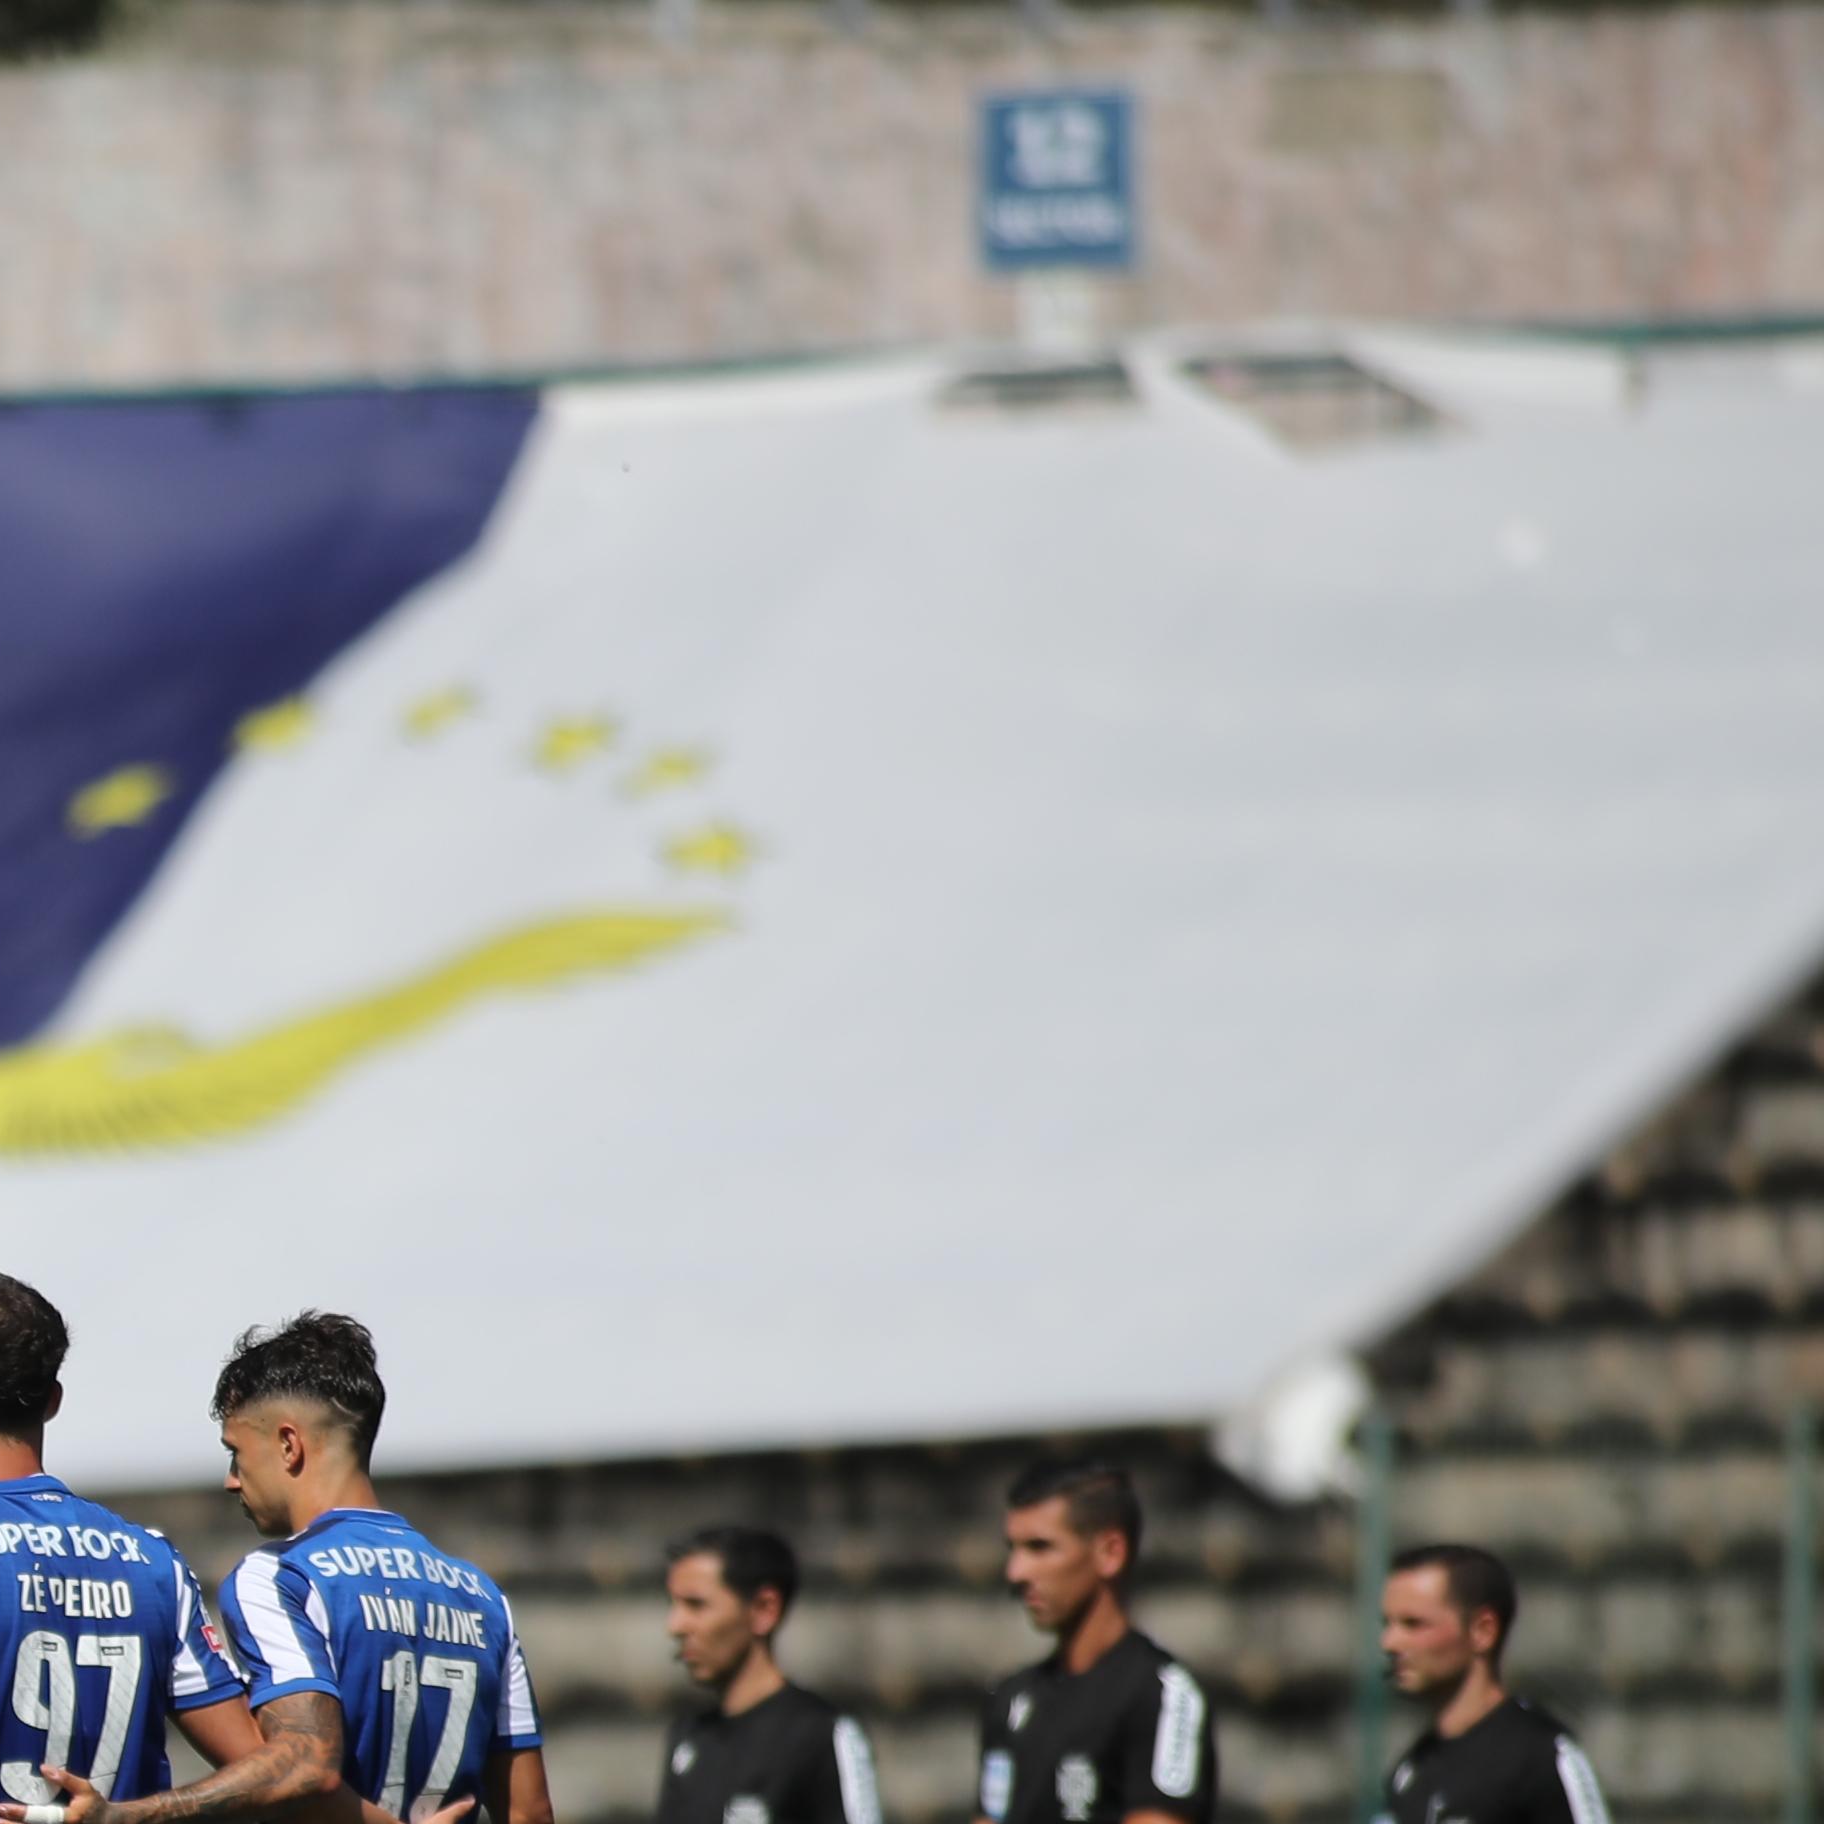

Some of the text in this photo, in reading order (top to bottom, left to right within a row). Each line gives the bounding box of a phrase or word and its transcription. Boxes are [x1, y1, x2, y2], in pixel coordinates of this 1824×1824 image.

[17, 1563, 47, 1612] ZÉ
[309, 1546, 492, 1601] SUPER BOCK
[359, 1587, 487, 1650] IVÁN JAIME
[0, 1630, 141, 1806] 97
